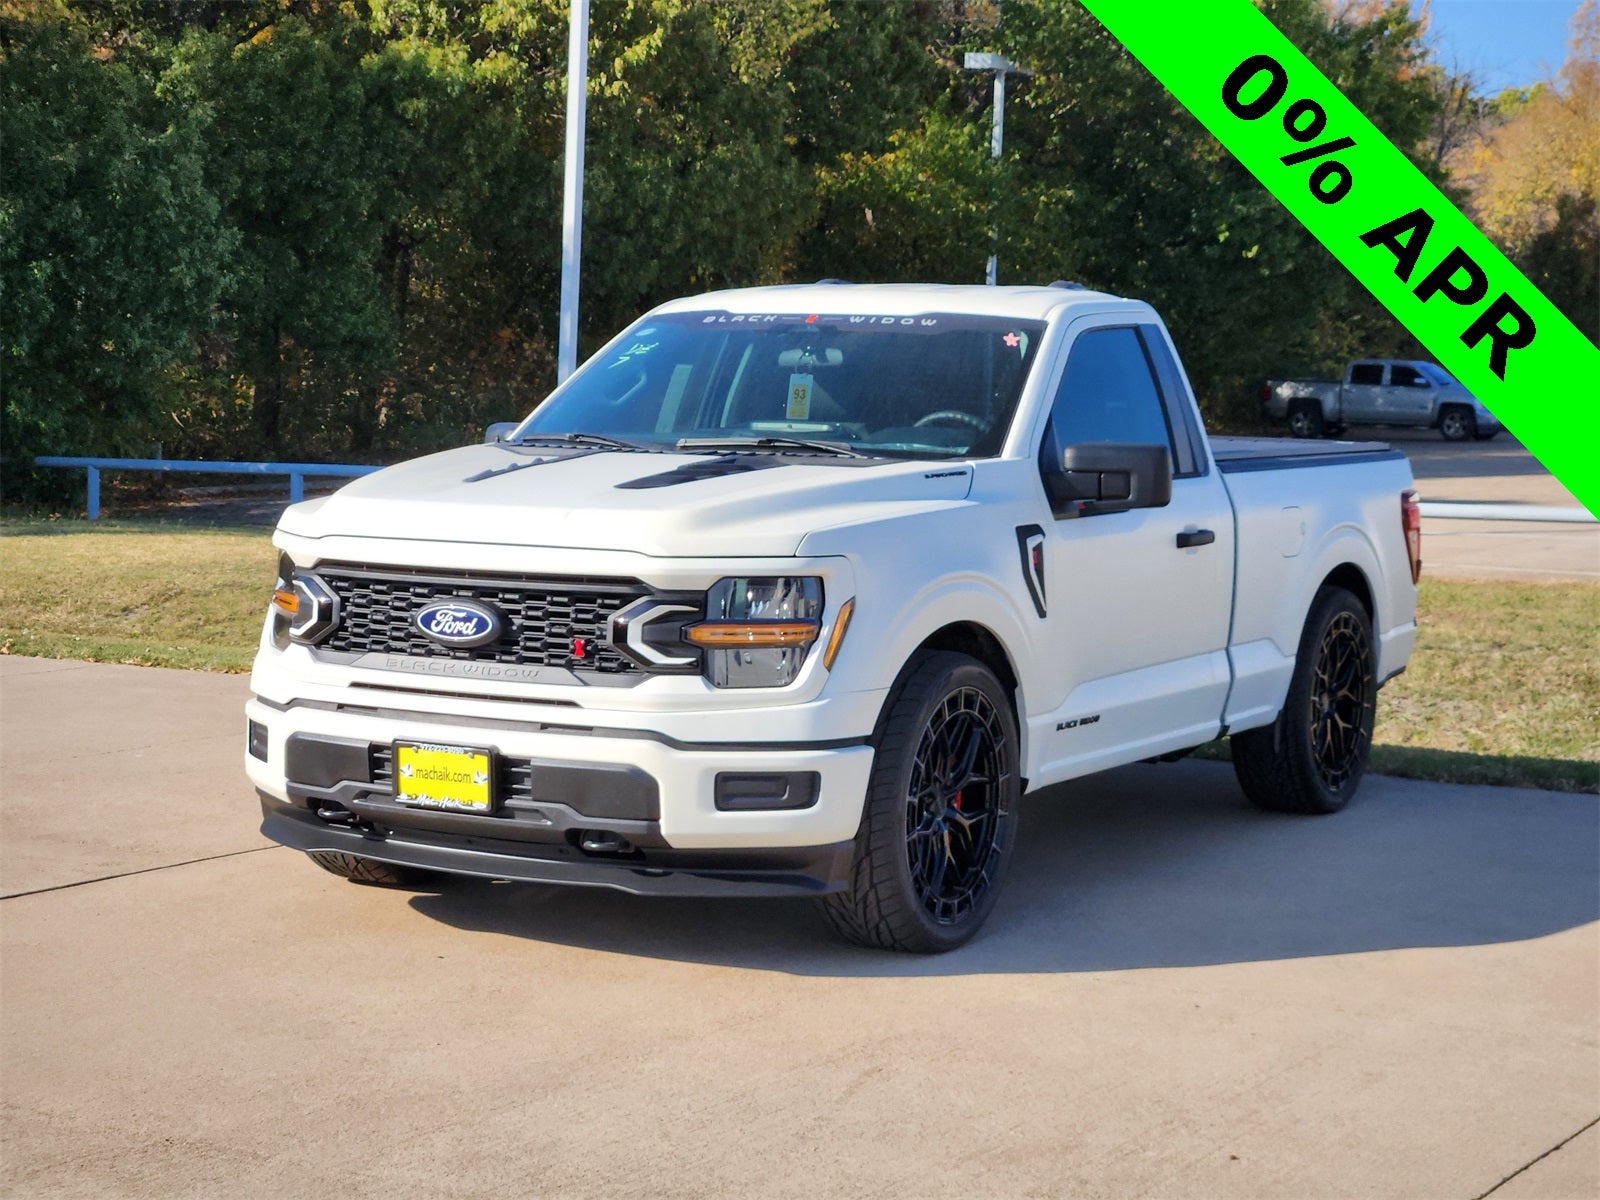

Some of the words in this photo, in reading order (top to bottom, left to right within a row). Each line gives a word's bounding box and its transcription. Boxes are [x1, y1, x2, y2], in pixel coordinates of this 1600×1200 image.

[702, 314, 778, 324] BLACK
[849, 315, 937, 327] WIDOW
[430, 609, 478, 636] Ford
[386, 657, 457, 674] BLACK
[462, 664, 542, 680] WIDOW
[415, 764, 472, 784] machaik.com
